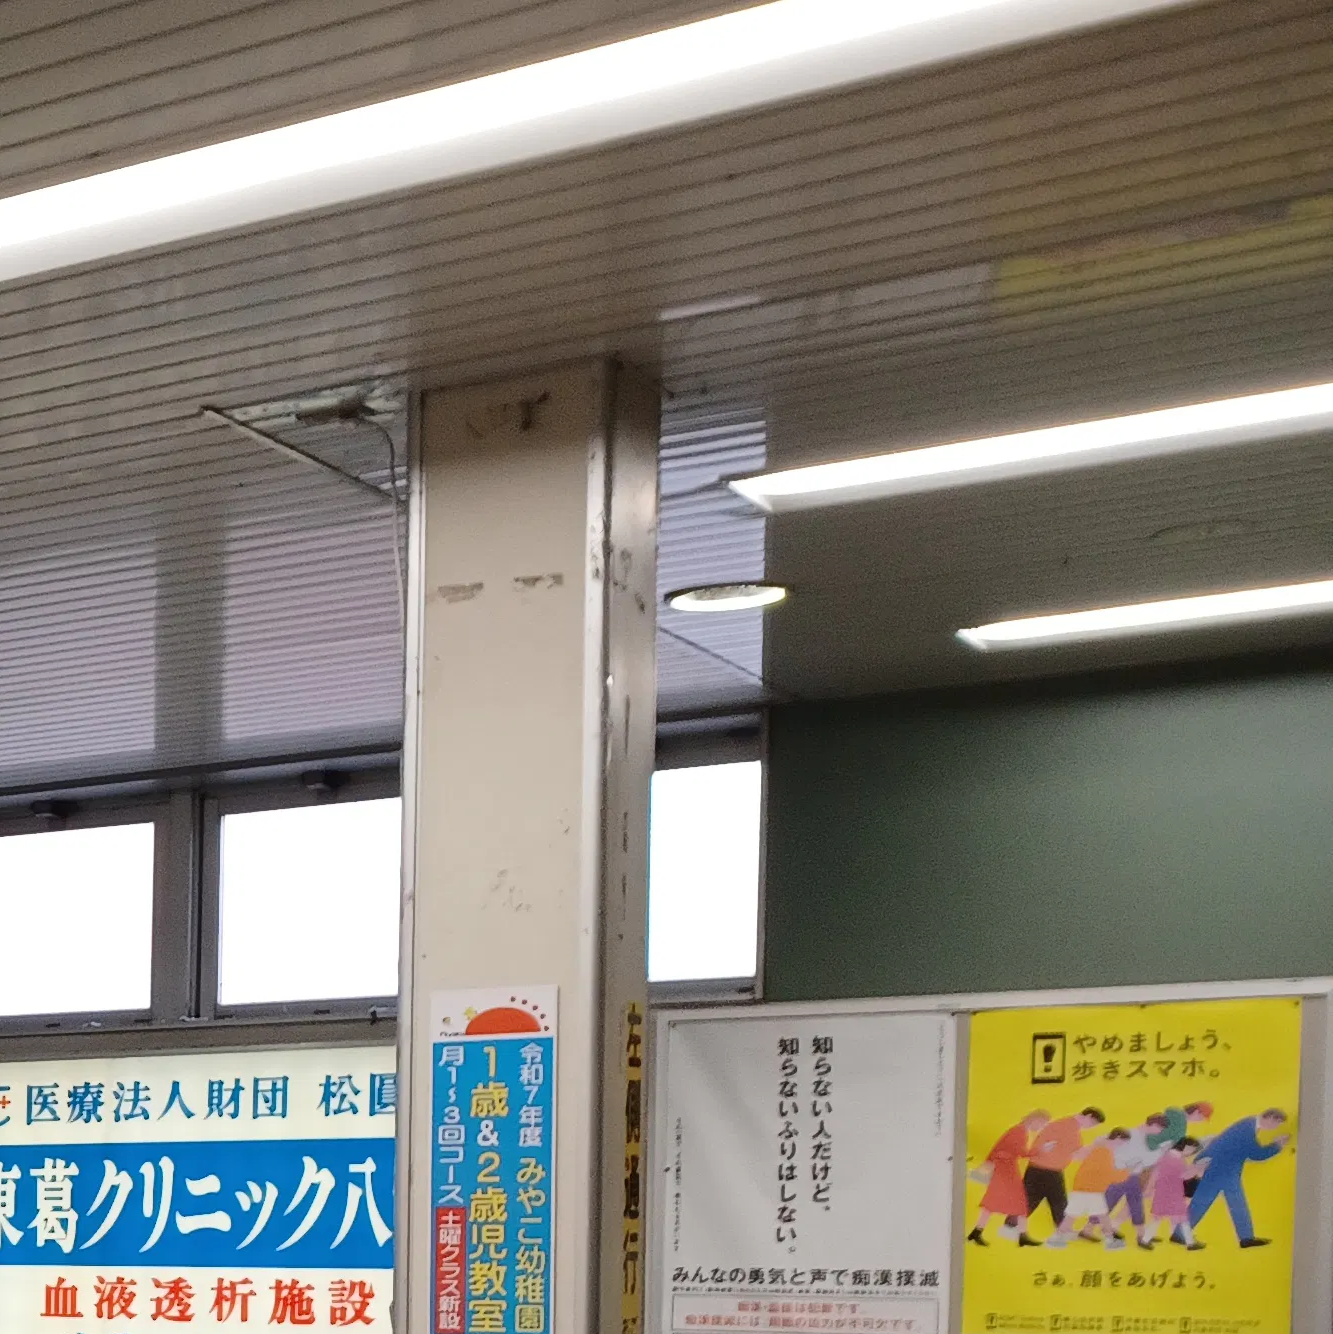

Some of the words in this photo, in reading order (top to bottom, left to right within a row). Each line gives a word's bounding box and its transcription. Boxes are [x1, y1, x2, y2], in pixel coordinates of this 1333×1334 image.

[1071, 1058, 1220, 1081] 歩きスマホ。
[1072, 1028, 1231, 1054] やめましょう、
[25, 1075, 290, 1126] 医療法人財団
[519, 1042, 544, 1147] 令和7年度
[776, 1037, 799, 1254] 知らないふりはしない。
[812, 1034, 833, 1212] 知らない人だけど。
[469, 1046, 509, 1333] 1歳&2歳児教室
[439, 1210, 462, 1330] 土曜クラス新設
[515, 1157, 546, 1334] みやこ幼稚園
[672, 1266, 940, 1287] みんなの勇気と声で痴漢撲滅
[39, 1275, 376, 1327] 血液透析施設
